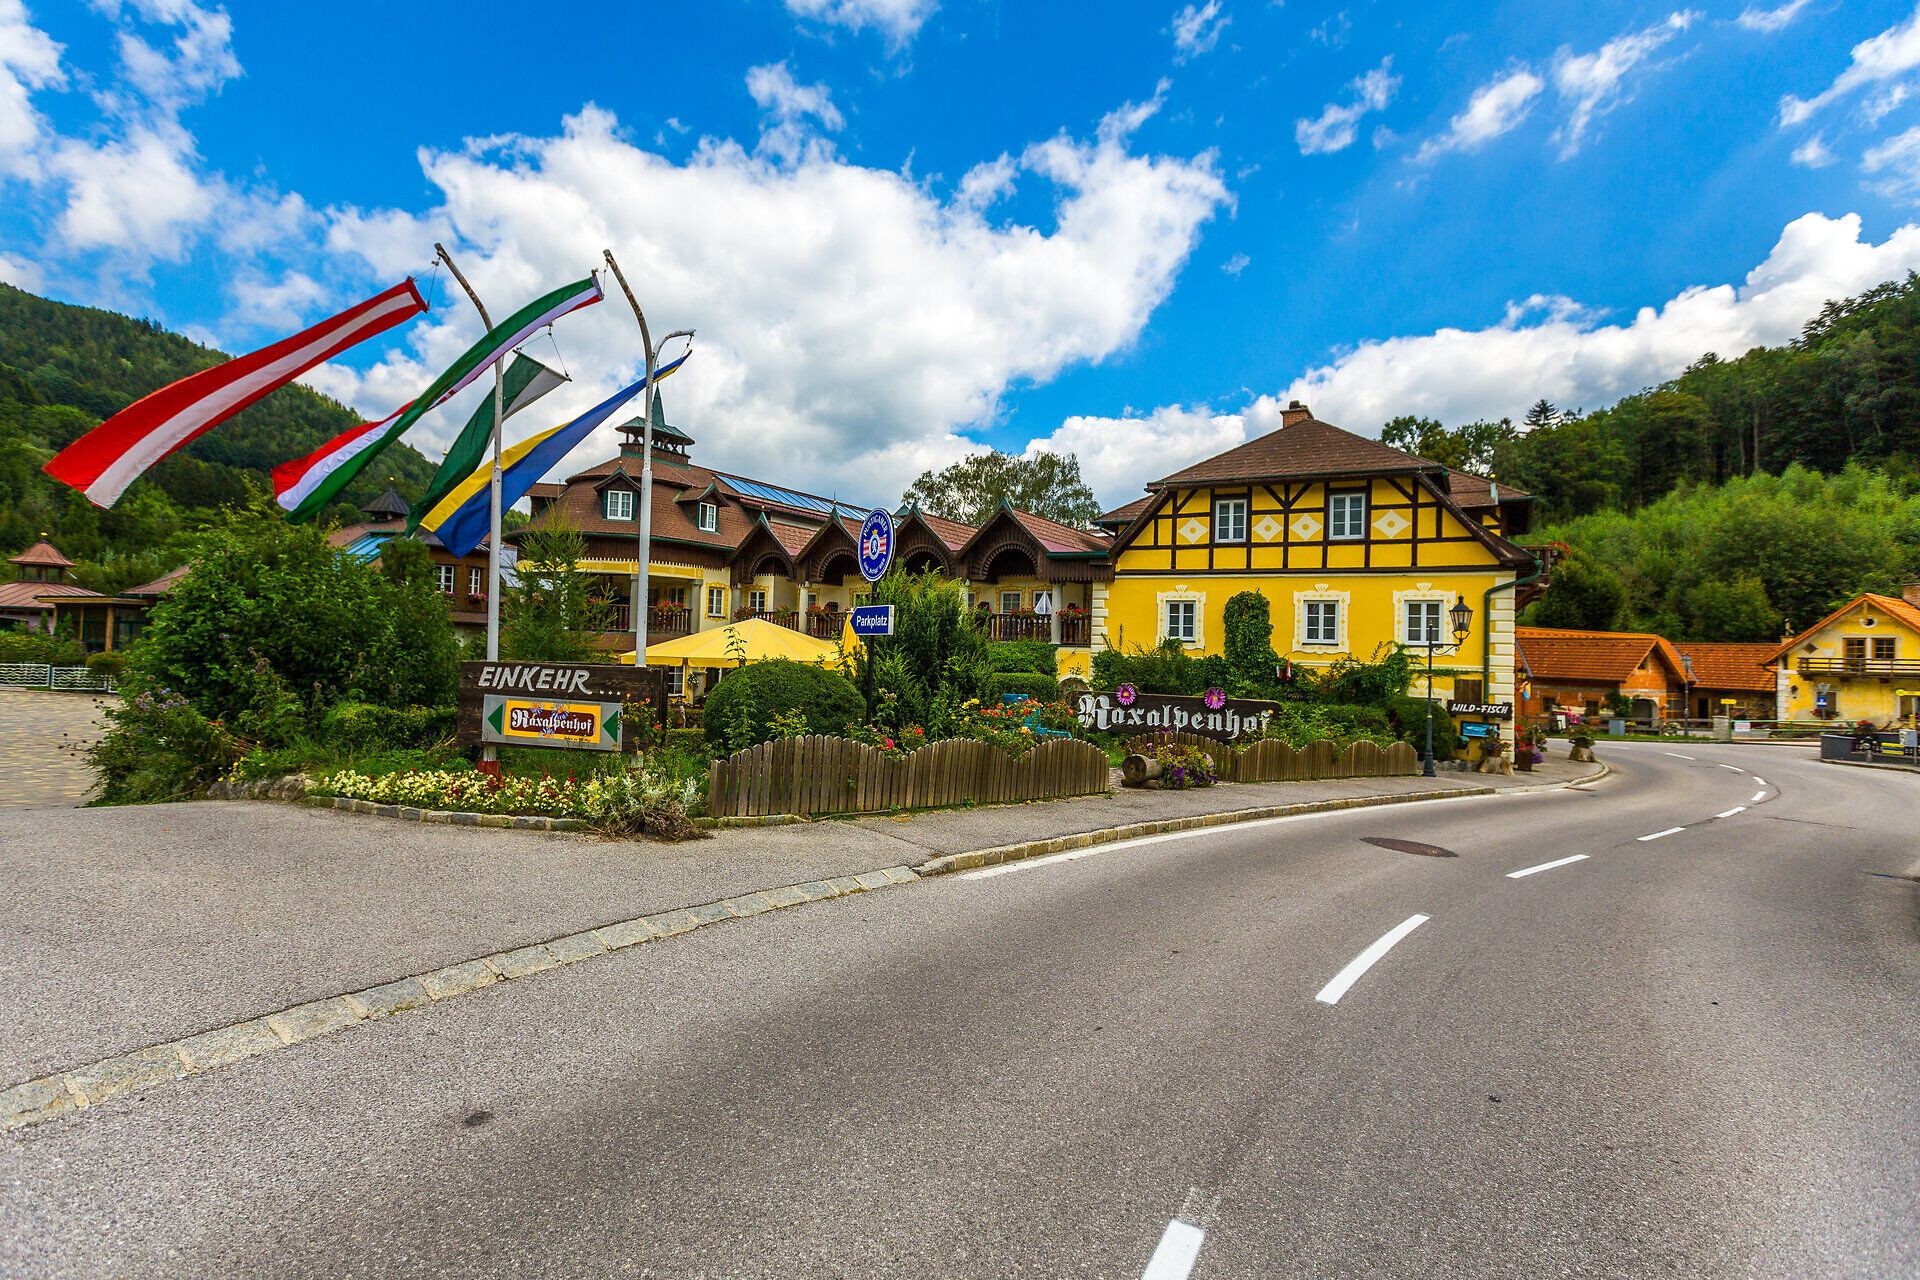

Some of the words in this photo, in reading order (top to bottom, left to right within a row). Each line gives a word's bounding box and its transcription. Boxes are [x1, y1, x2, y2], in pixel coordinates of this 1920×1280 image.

[856, 614, 887, 629] Parkplatz
[1077, 693, 1270, 739] Raxalpenhof
[1451, 703, 1508, 714] WILD-FISCH
[511, 709, 592, 733] Raxalpenhof
